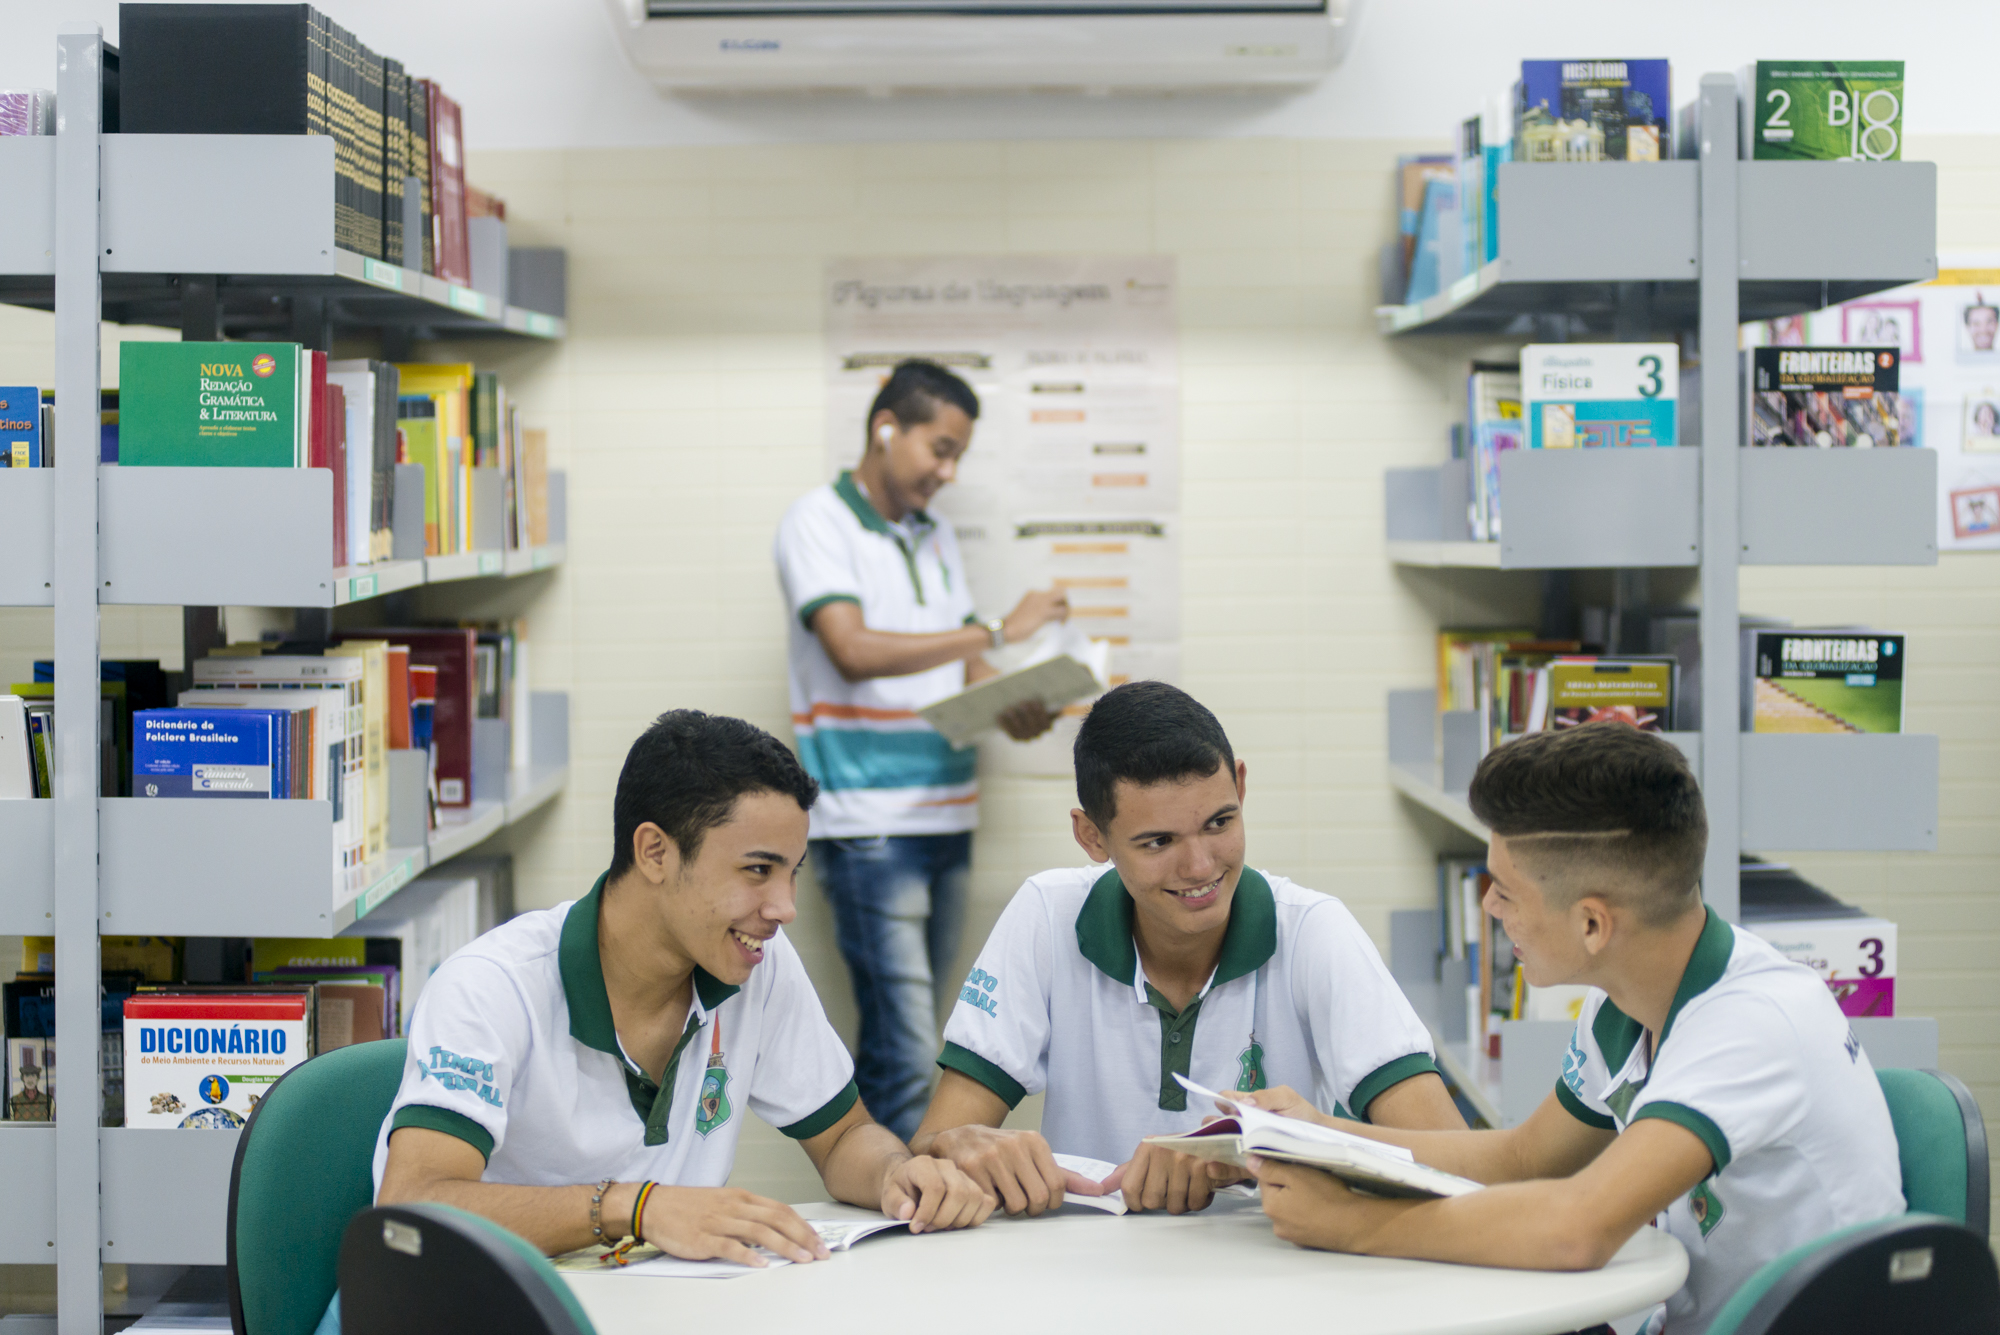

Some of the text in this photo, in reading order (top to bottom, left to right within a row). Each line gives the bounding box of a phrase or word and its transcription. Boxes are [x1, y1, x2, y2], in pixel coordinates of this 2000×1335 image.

[1766, 89, 1791, 127] 2
[1779, 351, 1890, 374] FRONTEIRAS 2
[200, 363, 243, 377] NOVA
[1543, 354, 1663, 398] Física 3
[1780, 374, 1796, 384] DA
[1799, 373, 1875, 385] GLOBALIZAÇÃO
[199, 408, 210, 420] &
[1781, 638, 1878, 661] FRONTEIRAS
[1782, 662, 1798, 670] DA
[1801, 661, 1878, 672] GLOBALIZAÇÃO
[146, 720, 214, 730] Dicionário do
[146, 732, 238, 743] Folclore Brasileiro
[195, 769, 246, 779] Câmara
[202, 777, 253, 789] Cascudo
[1858, 938, 1884, 978] 3
[140, 1024, 286, 1055] DICIONÁRIO
[141, 1056, 151, 1064] do
[153, 1056, 171, 1064] Meio
[173, 1056, 210, 1065] Ambiente
[218, 1057, 251, 1066] Recursos
[253, 1057, 285, 1066] Naturais
[429, 1046, 494, 1082] TEMPO
